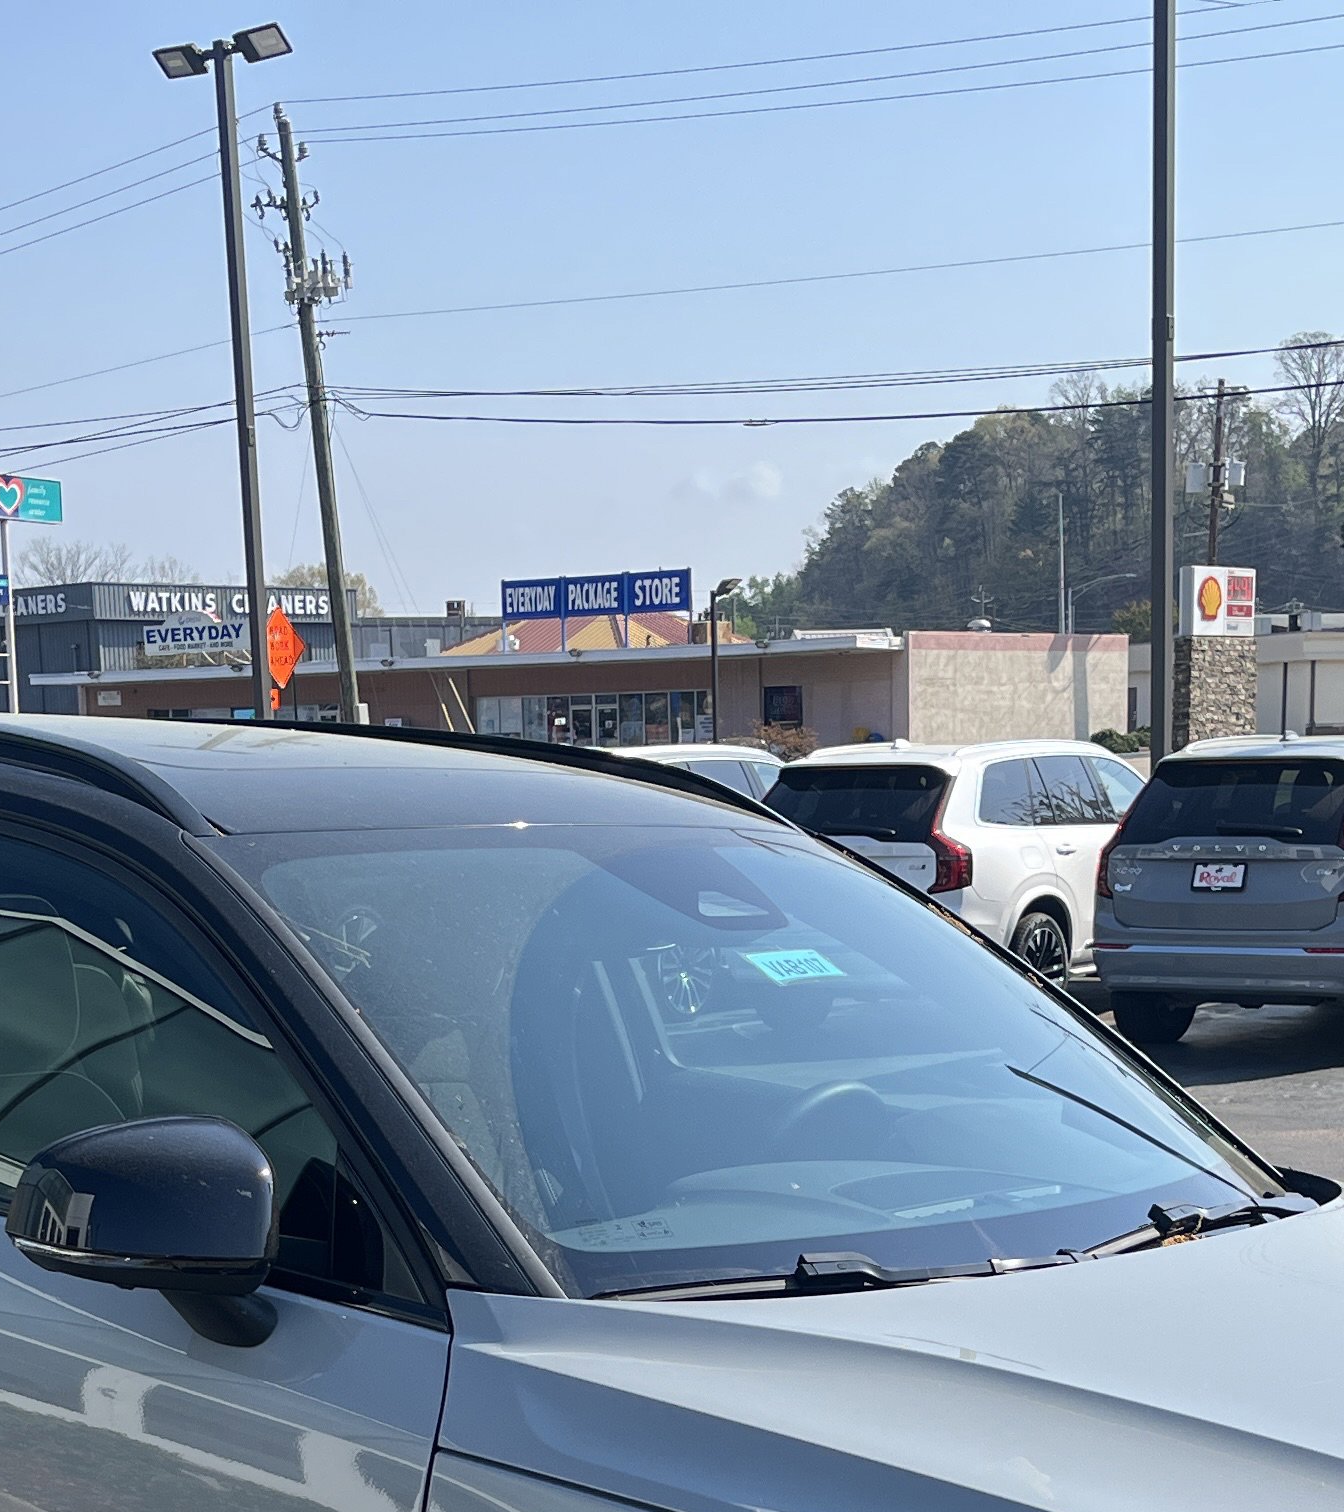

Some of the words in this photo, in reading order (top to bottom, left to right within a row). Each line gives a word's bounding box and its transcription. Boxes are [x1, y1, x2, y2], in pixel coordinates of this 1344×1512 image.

[129, 591, 216, 613] WATKINS
[506, 585, 556, 614] EVERYDAY
[568, 581, 619, 611] PACKAGE
[634, 576, 681, 606] STORE
[145, 623, 244, 644] EVERYDAY
[270, 654, 294, 666] AHEAD
[1199, 871, 1237, 886] Royal
[761, 958, 831, 977] VAB107
